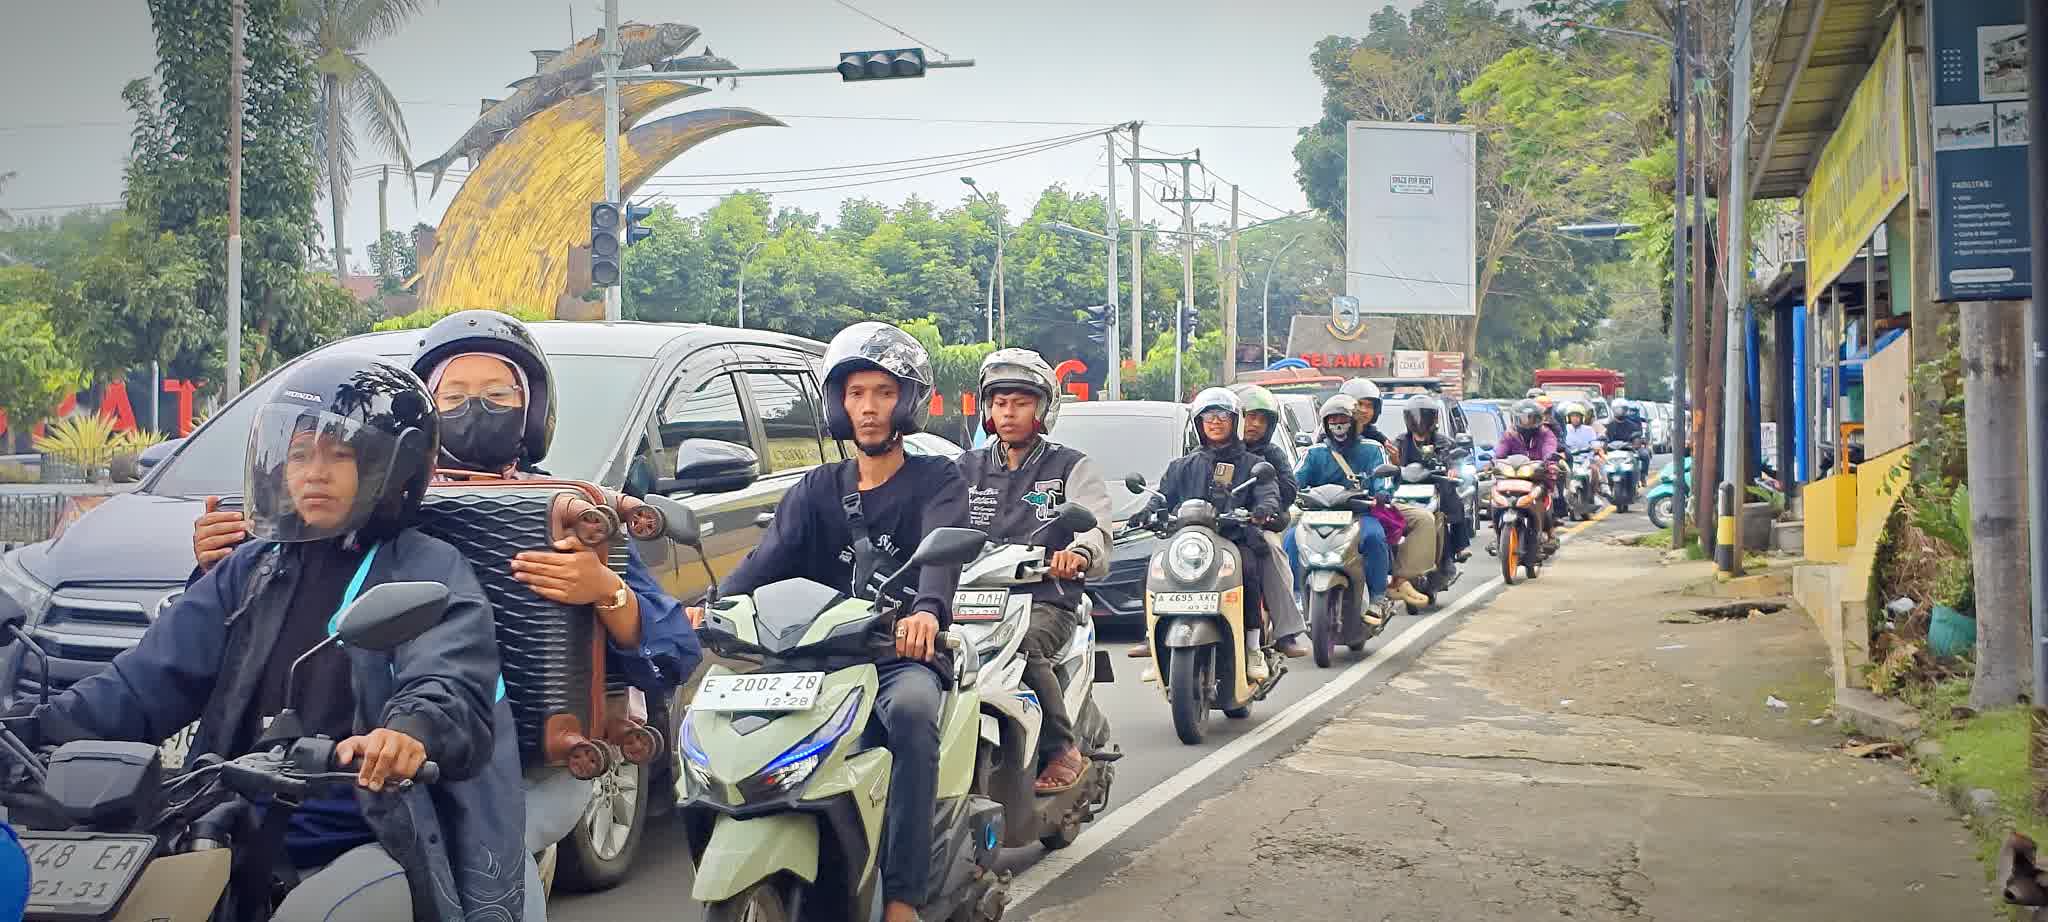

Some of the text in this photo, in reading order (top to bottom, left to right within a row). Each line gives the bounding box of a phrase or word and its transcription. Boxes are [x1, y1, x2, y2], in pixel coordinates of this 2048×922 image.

[1300, 352, 1385, 369] SELAMAT
[703, 679, 717, 693] E
[731, 676, 781, 692] 2002
[763, 696, 809, 707] 12-28
[92, 844, 139, 871] EA
